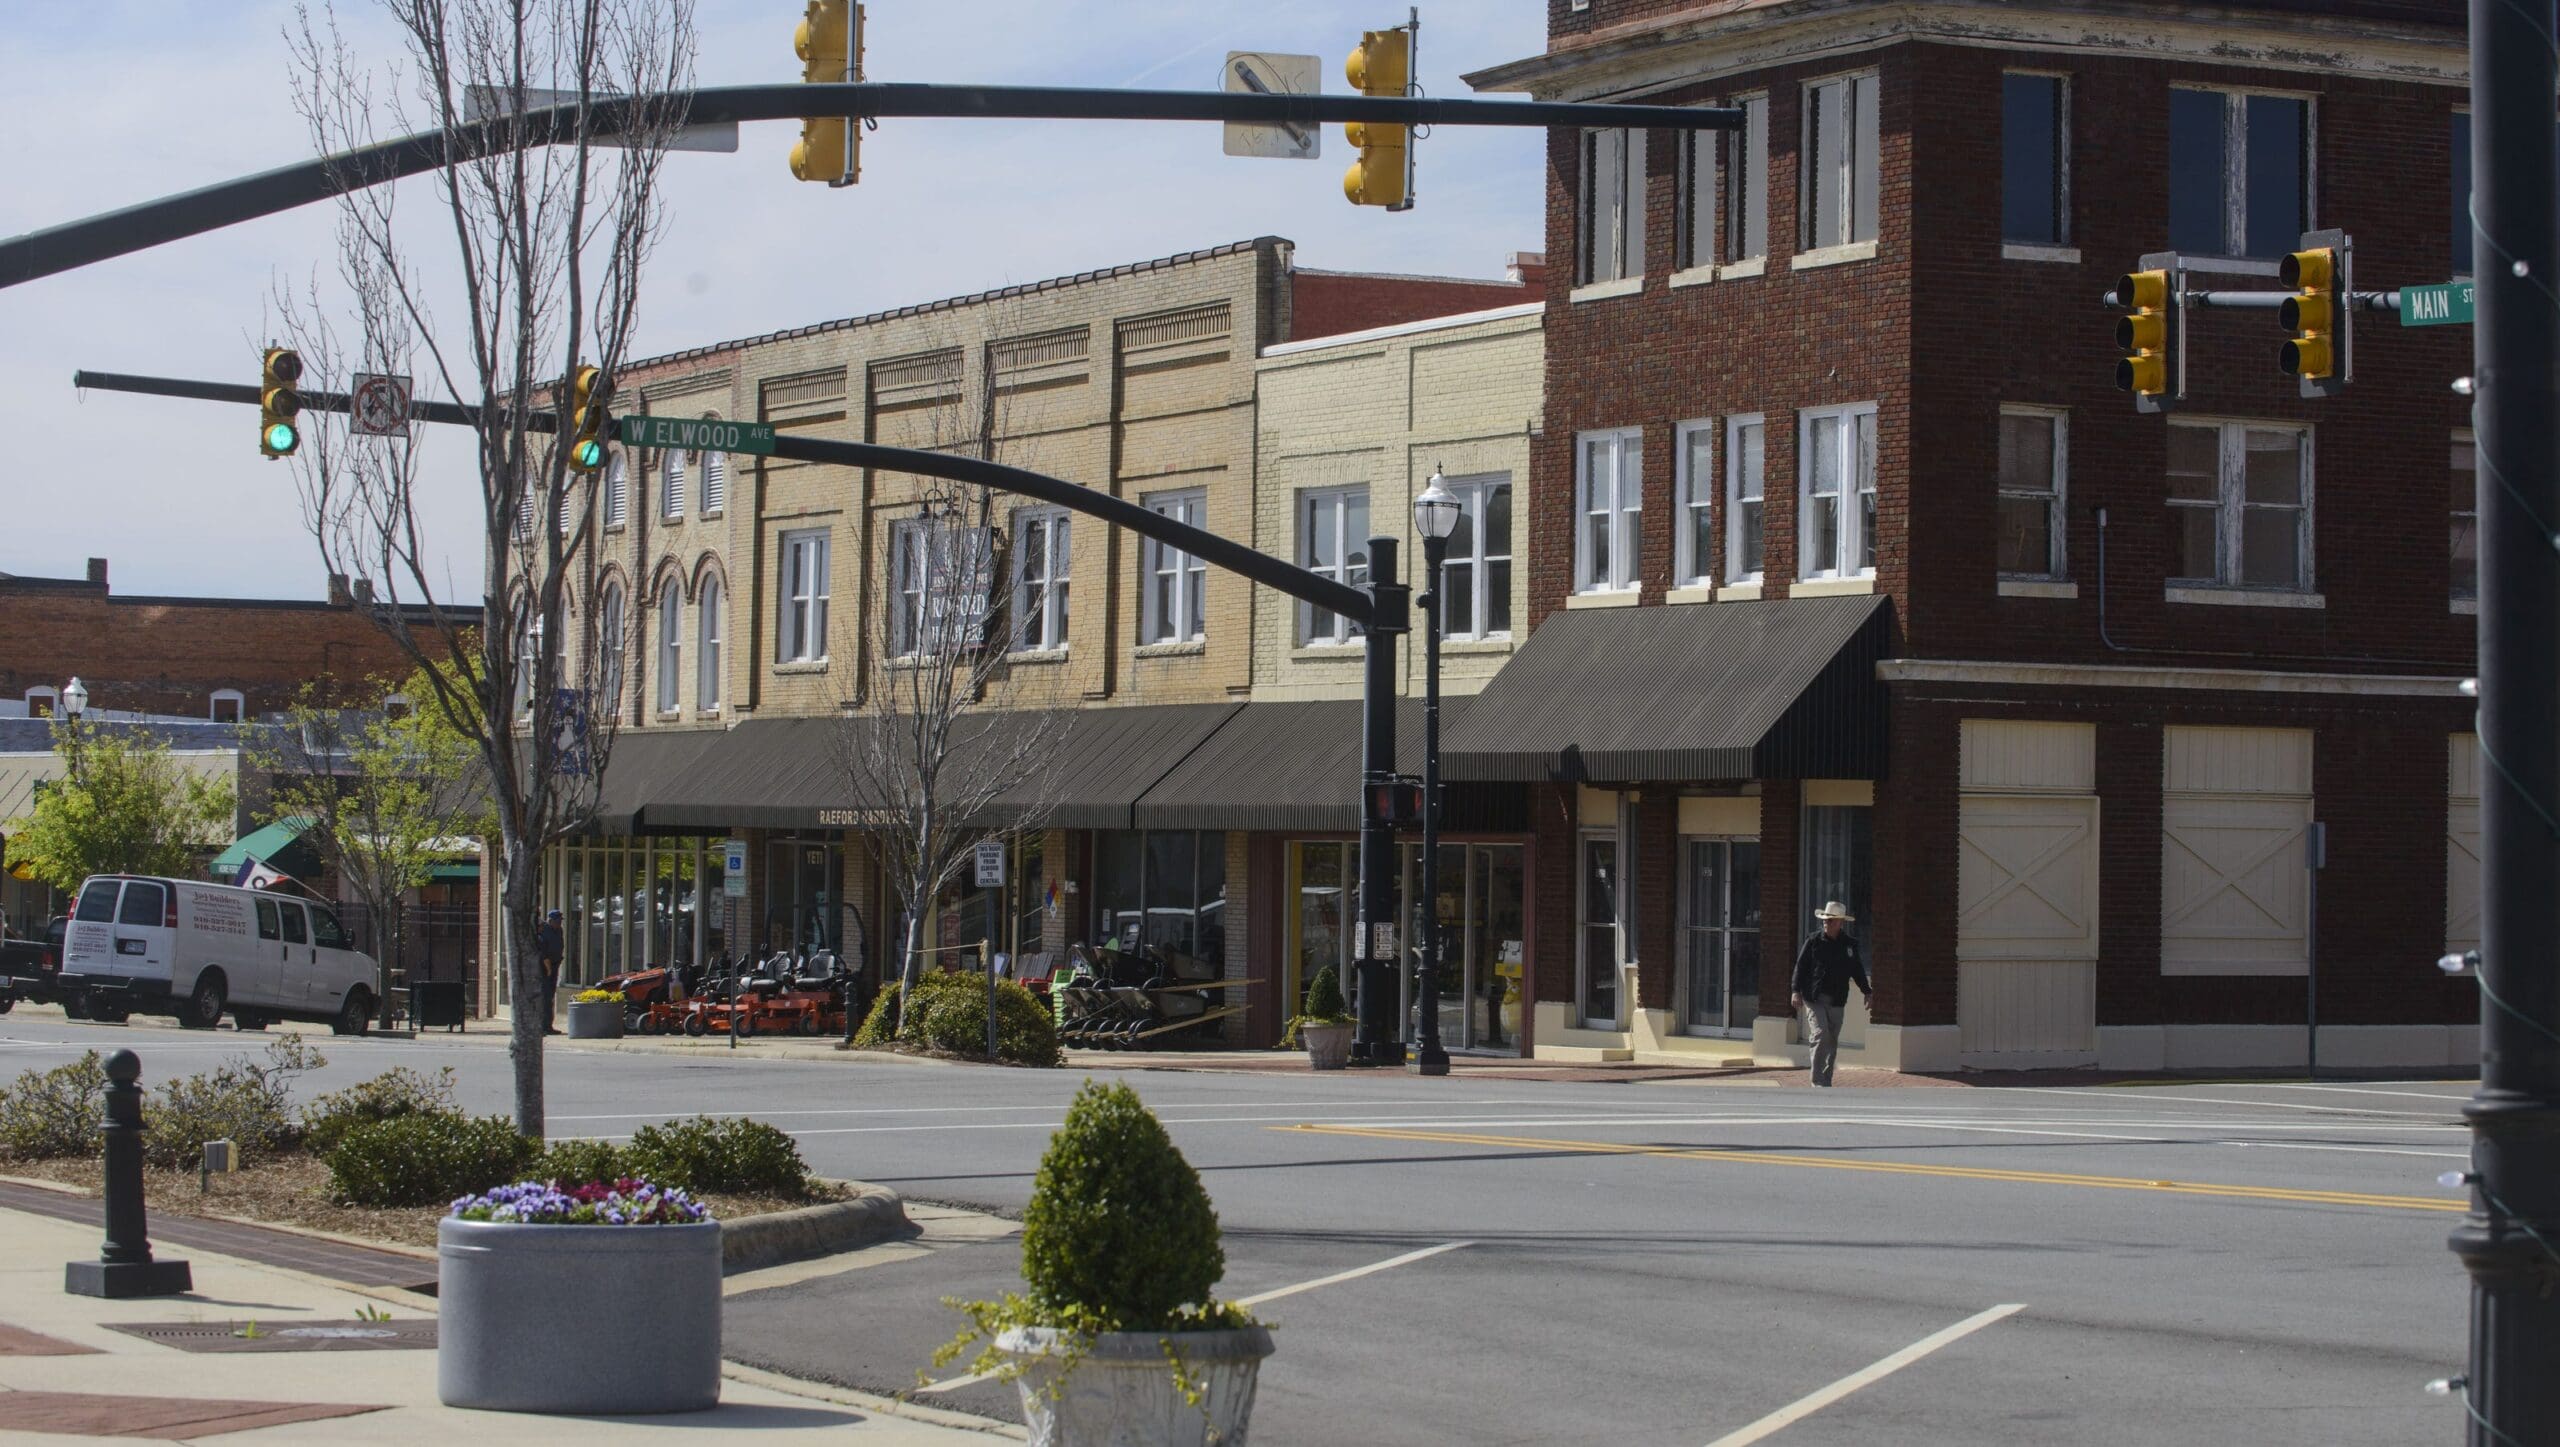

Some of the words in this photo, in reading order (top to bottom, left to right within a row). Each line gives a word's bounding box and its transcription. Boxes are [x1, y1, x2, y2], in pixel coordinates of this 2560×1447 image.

[2412, 290, 2449, 320] MAIN
[2463, 288, 2473, 303] ST
[631, 420, 647, 442] W
[656, 422, 739, 448] ELWOOD
[751, 427, 770, 440] AVE
[933, 594, 985, 618] RORD
[820, 810, 858, 825] RAEFORD
[806, 850, 823, 865] YETI
